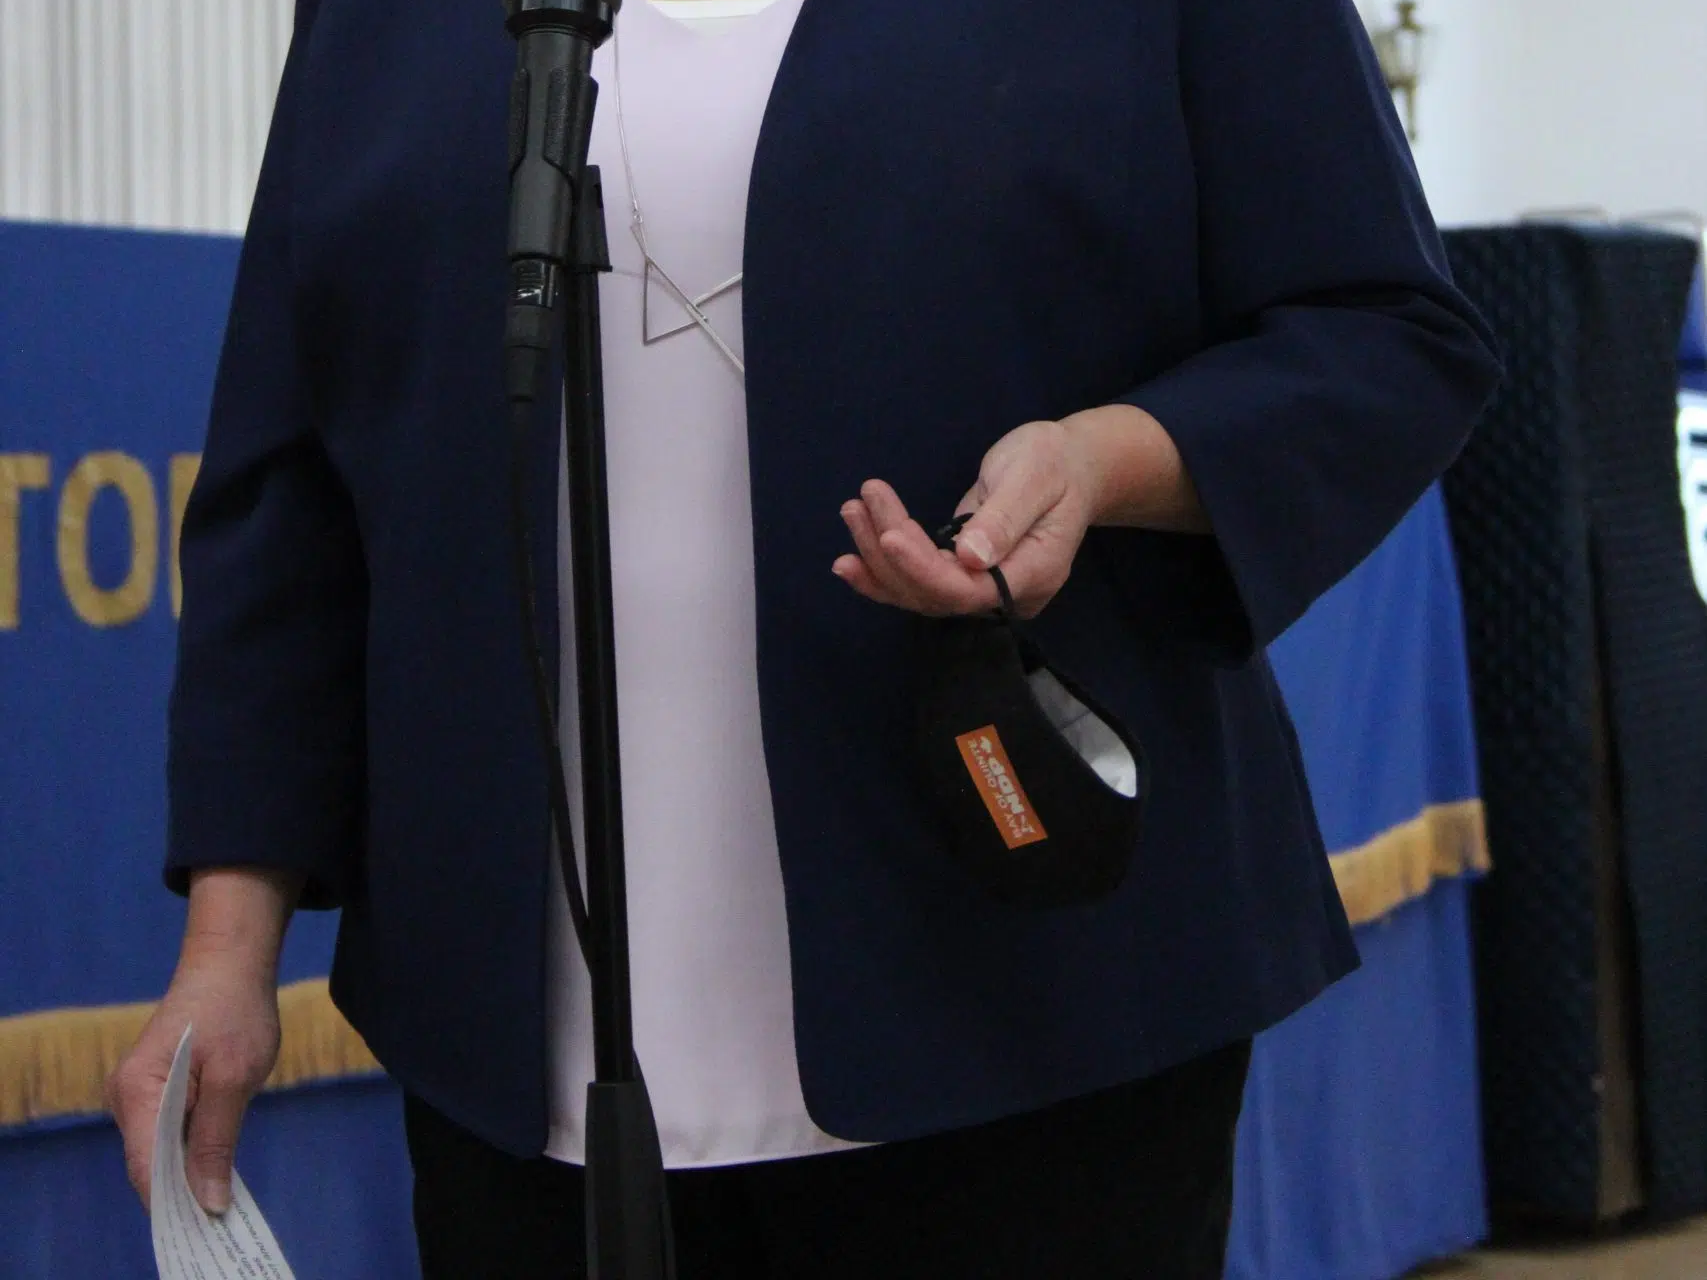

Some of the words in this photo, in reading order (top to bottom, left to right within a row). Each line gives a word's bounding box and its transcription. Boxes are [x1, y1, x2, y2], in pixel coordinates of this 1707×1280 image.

[988, 756, 1025, 814] NDP
[992, 791, 1008, 809] OF
[1004, 812, 1023, 839] BAY
